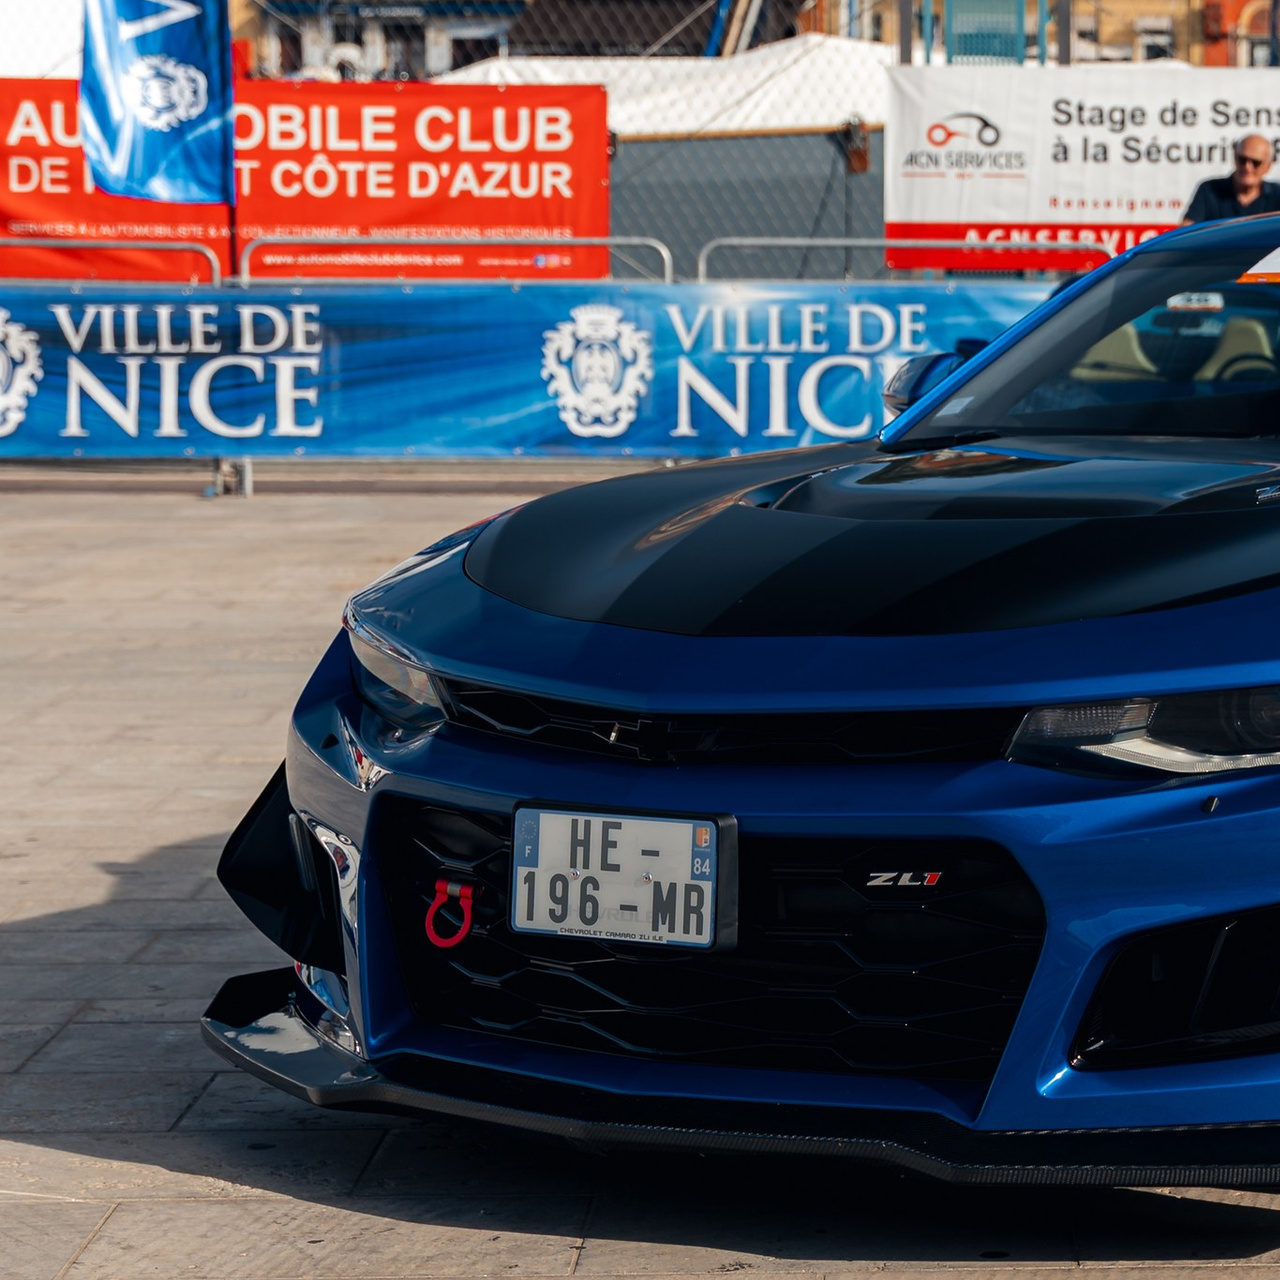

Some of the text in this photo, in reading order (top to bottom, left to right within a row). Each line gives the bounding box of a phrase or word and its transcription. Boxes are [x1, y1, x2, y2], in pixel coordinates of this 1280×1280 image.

[6, 101, 574, 152] AUOBILE CLUB
[1053, 98, 1146, 132] Stage
[1159, 100, 1198, 126] de
[903, 151, 1027, 169] ACN SERVICES
[1052, 134, 1069, 163] à
[1082, 136, 1108, 163] la
[1122, 135, 1238, 163] Sécurit
[8, 156, 71, 194] DE
[270, 154, 394, 198] CÔTE
[408, 161, 574, 198] D'AZUR
[1050, 196, 1184, 211] Renseignem
[964, 228, 1166, 254] ACNSERVIC
[48, 303, 323, 354] VILLE DE
[664, 303, 928, 353] VILLE DE
[58, 354, 323, 438] NICE
[525, 845, 532, 858] F
[694, 858, 710, 875] 84
[866, 872, 942, 886] ZL1
[559, 927, 602, 937] CHEVROLET
[605, 931, 636, 939] CAMARO
